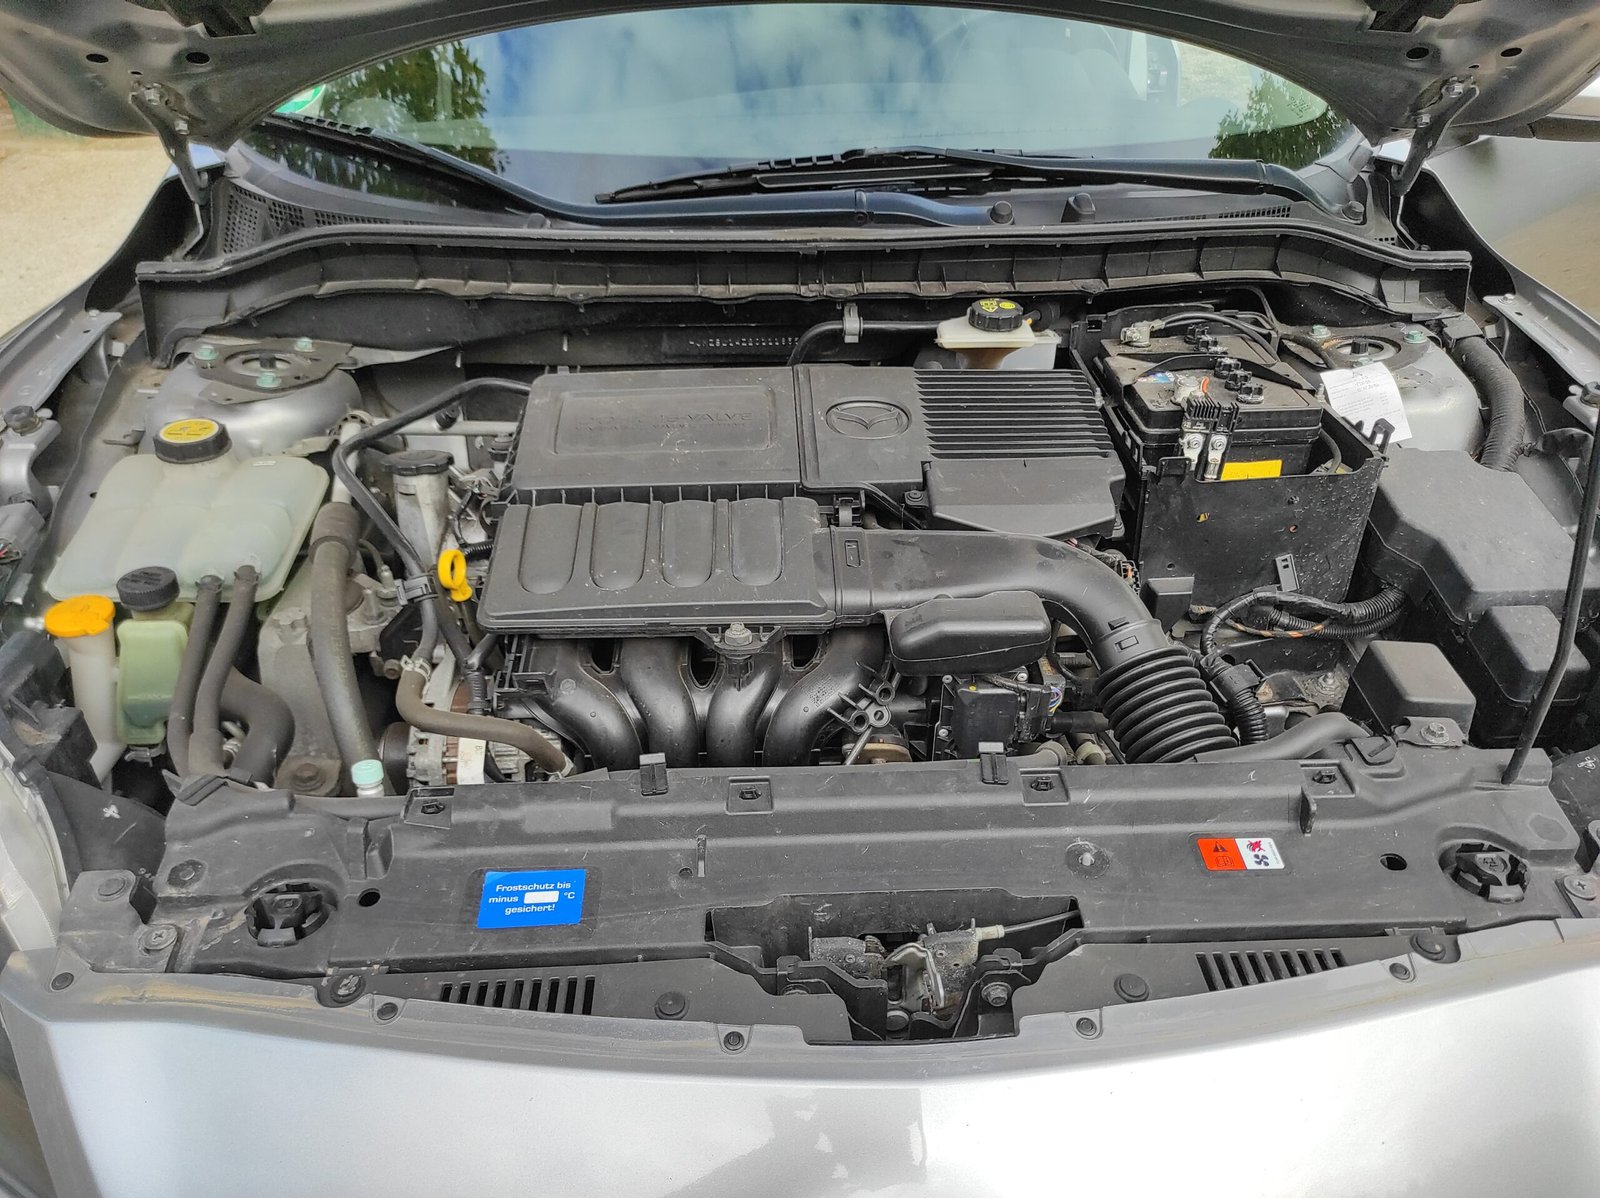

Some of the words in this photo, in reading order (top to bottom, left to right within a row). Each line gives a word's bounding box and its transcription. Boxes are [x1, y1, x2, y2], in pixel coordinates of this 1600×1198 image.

[495, 883, 555, 892] Frostschutz
[557, 881, 571, 889] bis
[488, 895, 519, 904] minus
[563, 891, 576, 899] °C
[504, 904, 555, 916] gesichert!
